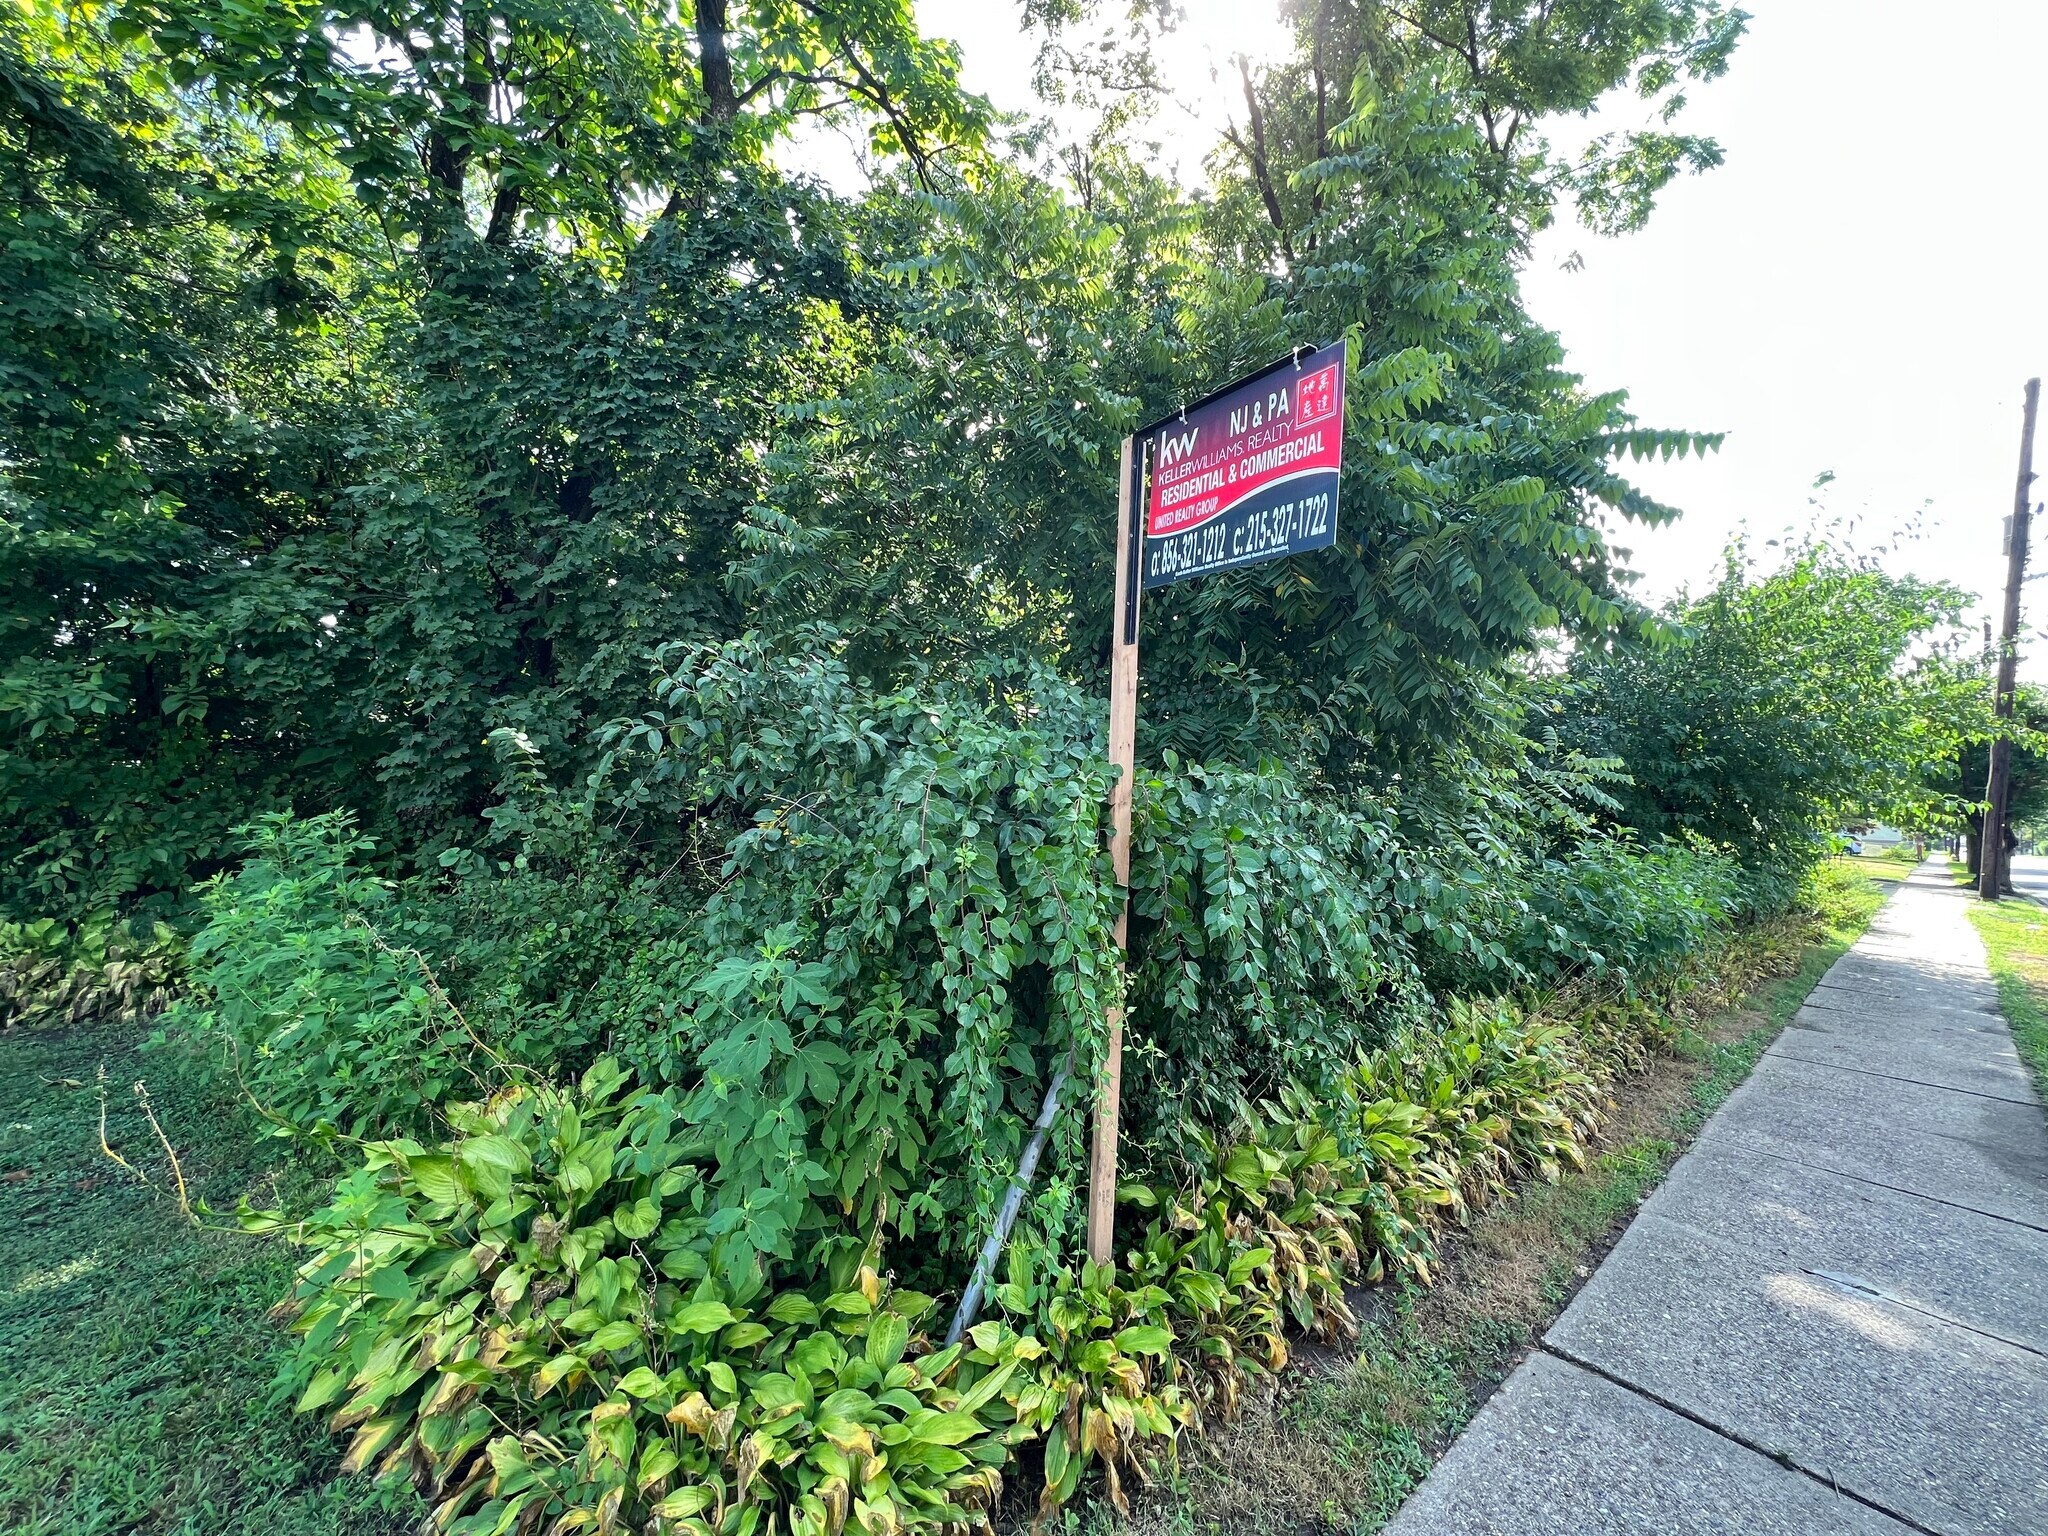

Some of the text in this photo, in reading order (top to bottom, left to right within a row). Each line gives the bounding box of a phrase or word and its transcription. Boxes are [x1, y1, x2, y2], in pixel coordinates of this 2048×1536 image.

[1230, 387, 1289, 438] NJ & PA
[1247, 419, 1294, 451] REALTY
[1161, 430, 1325, 508] RESIDENTIAL & COMMERCIAL
[1154, 496, 1219, 530] UNITED REALTY GROUP
[1161, 522, 1226, 574] 856-321-1212
[1245, 492, 1328, 552] 215-327-1722
